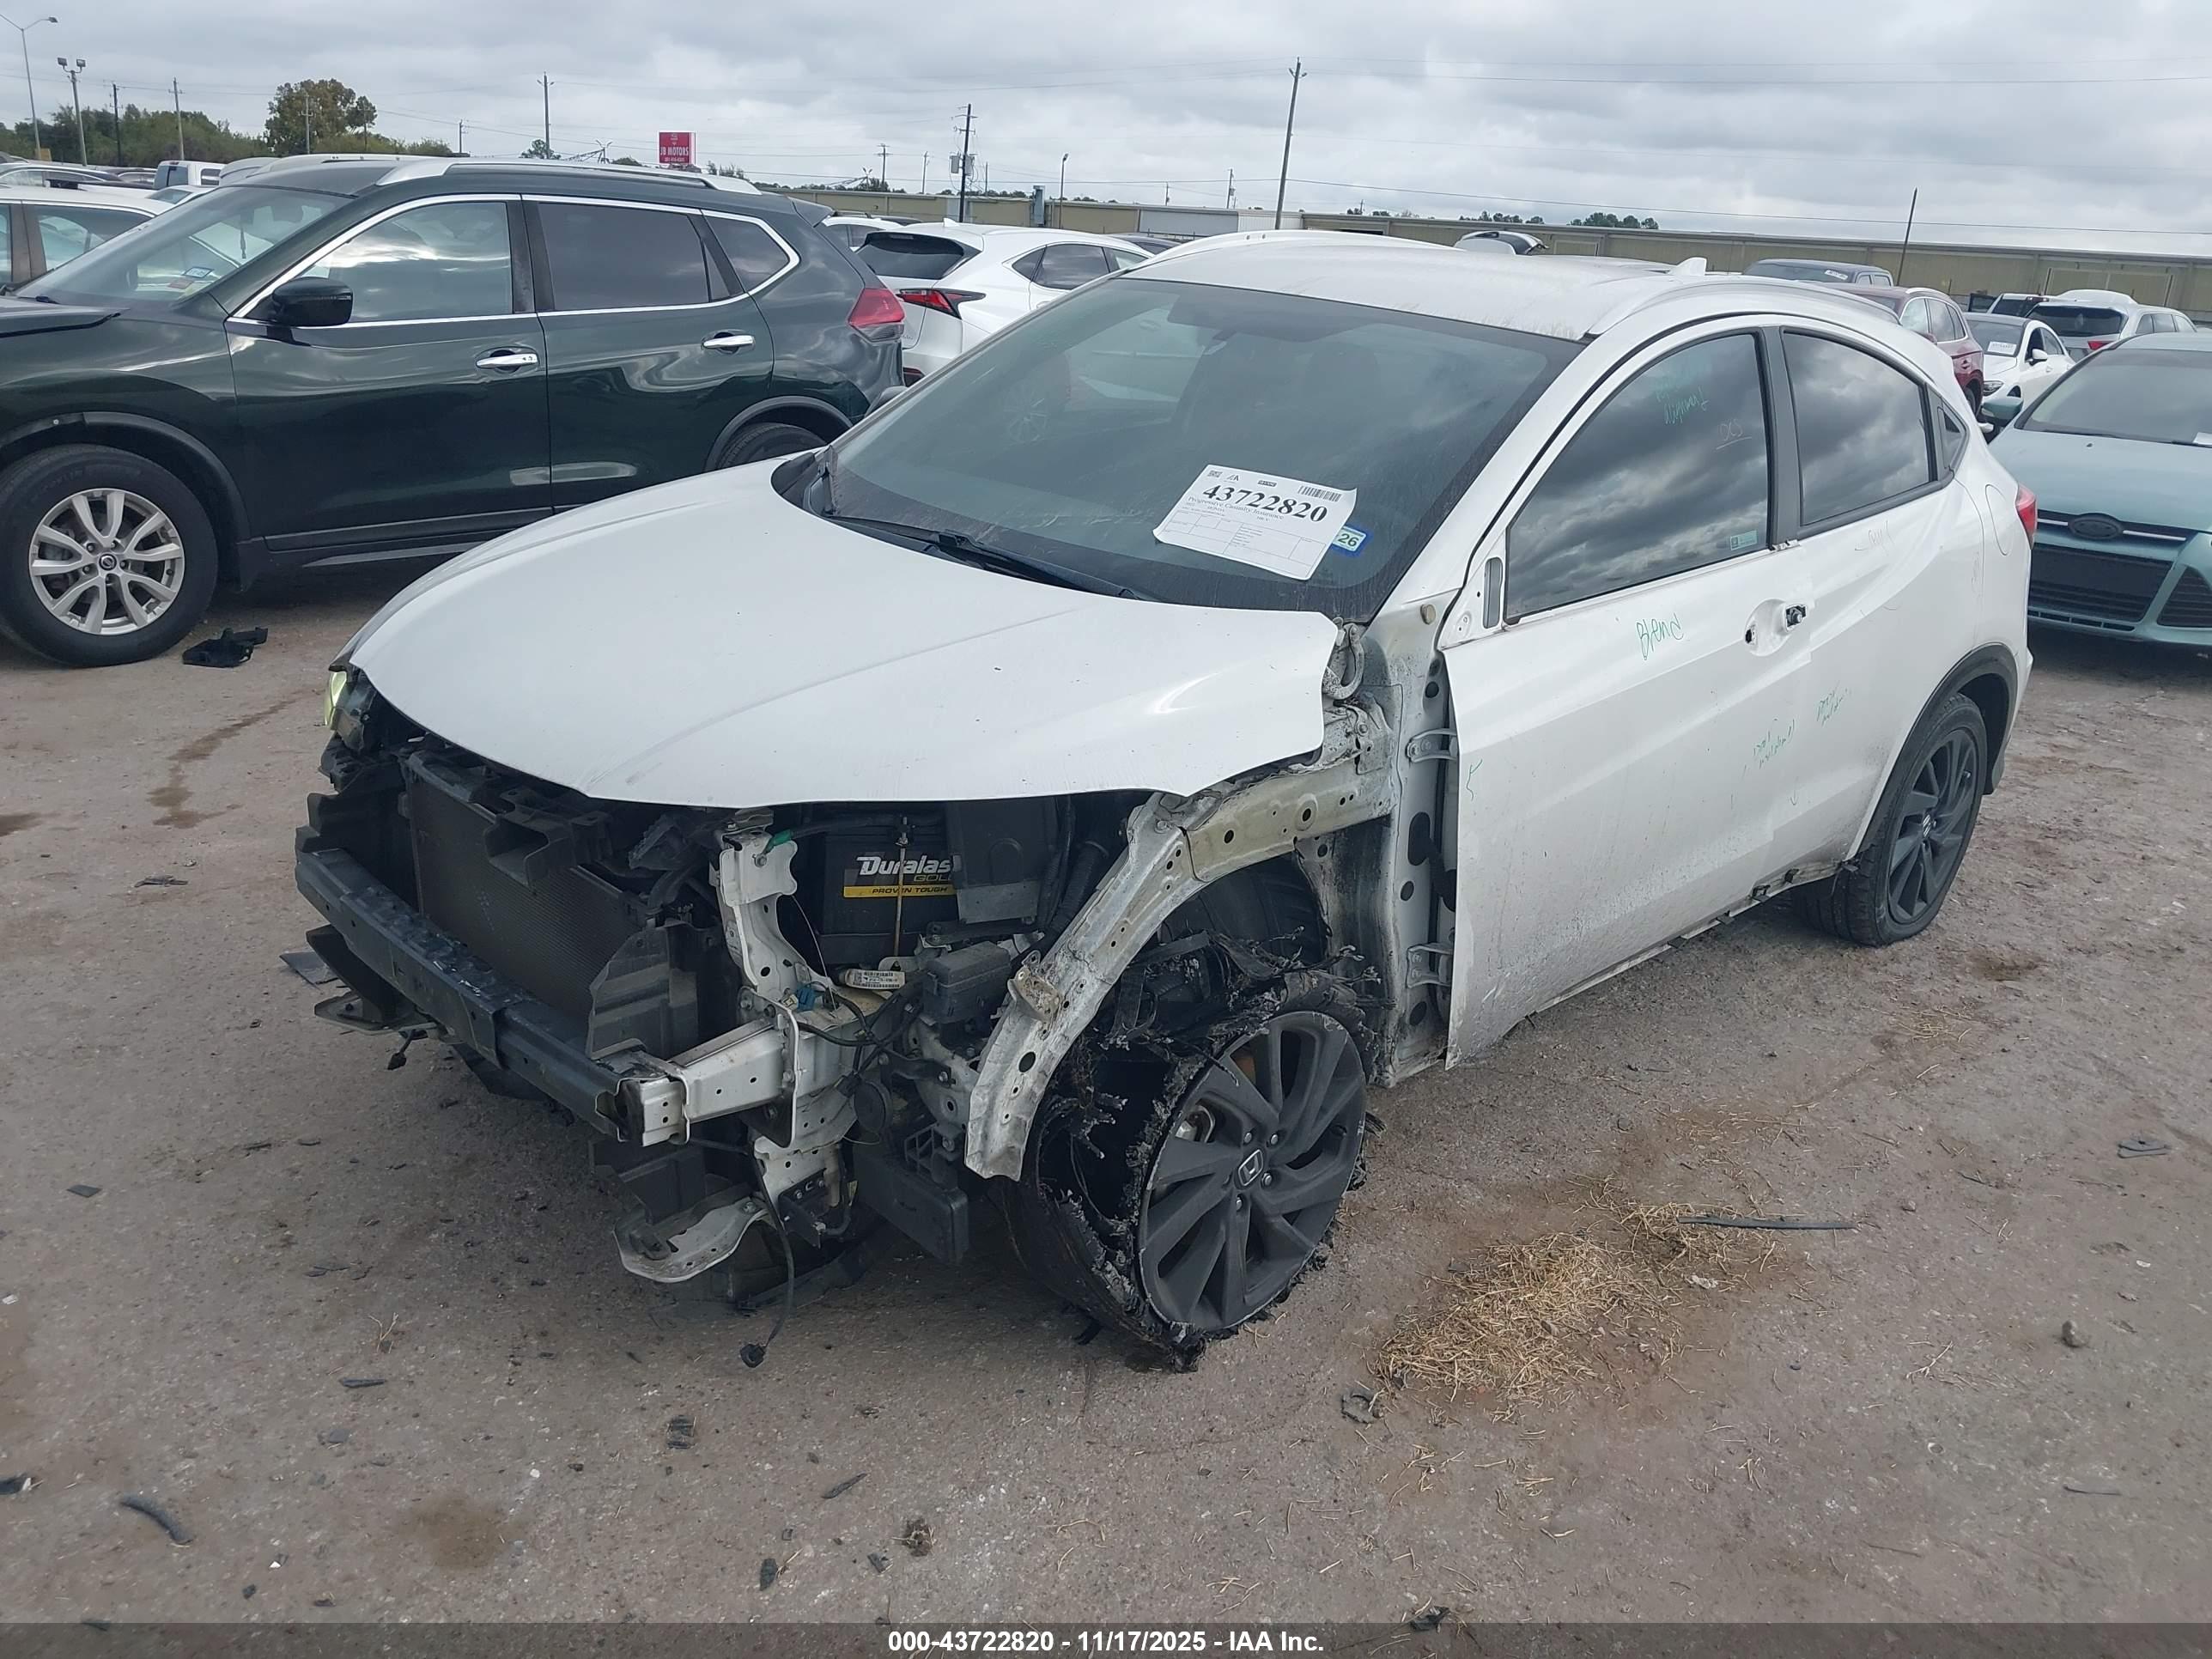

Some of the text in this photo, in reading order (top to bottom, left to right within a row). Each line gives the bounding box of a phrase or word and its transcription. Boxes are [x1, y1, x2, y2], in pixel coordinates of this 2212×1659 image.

[667, 147, 689, 155] MOTORS
[1188, 495, 1224, 507] Progressive
[1224, 501, 1253, 514] Casualty
[1254, 508, 1285, 520] Insurance
[1203, 485, 1328, 522] 43722820
[1338, 533, 1359, 547] 26
[857, 854, 951, 875] Duralas
